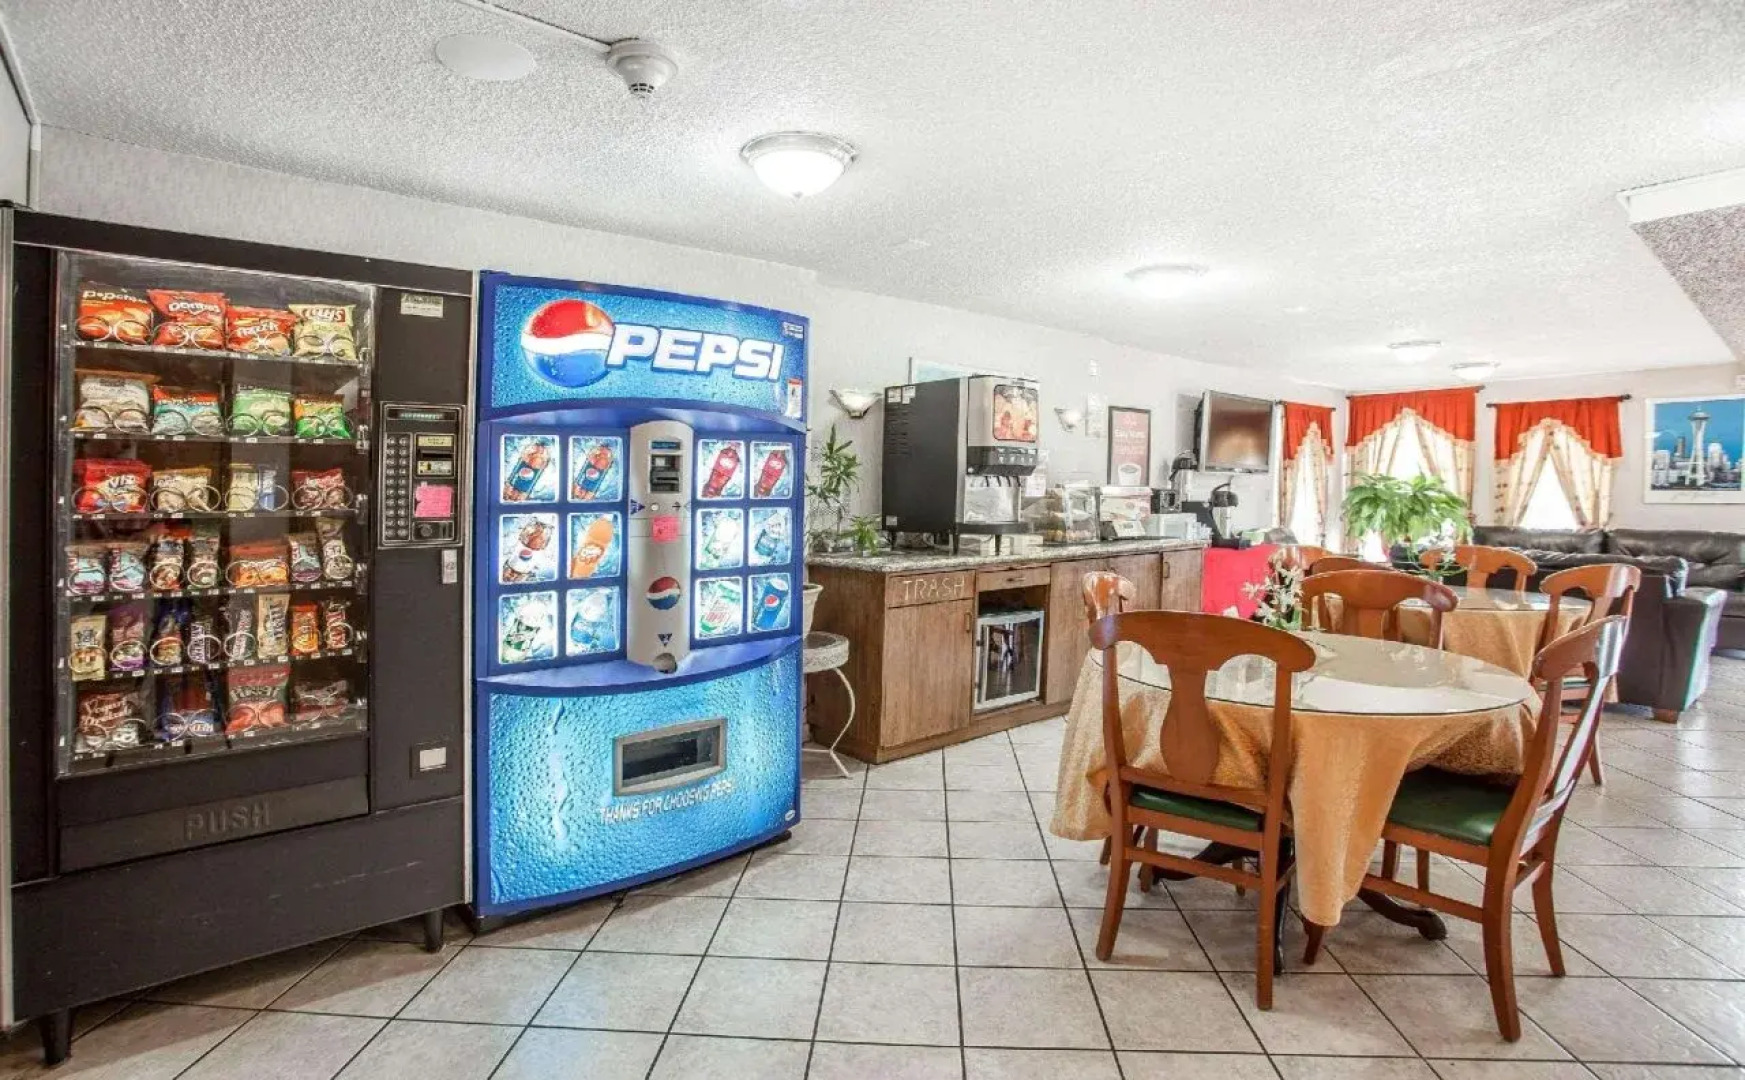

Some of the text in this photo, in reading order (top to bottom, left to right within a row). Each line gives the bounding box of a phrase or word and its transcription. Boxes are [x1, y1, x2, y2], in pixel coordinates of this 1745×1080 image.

[605, 323, 785, 381] PEPSI
[902, 575, 965, 600] TRASH
[184, 803, 270, 840] PUSH
[600, 802, 640, 824] THANKS
[642, 798, 662, 816] FOR
[711, 779, 736, 797] PEPS
